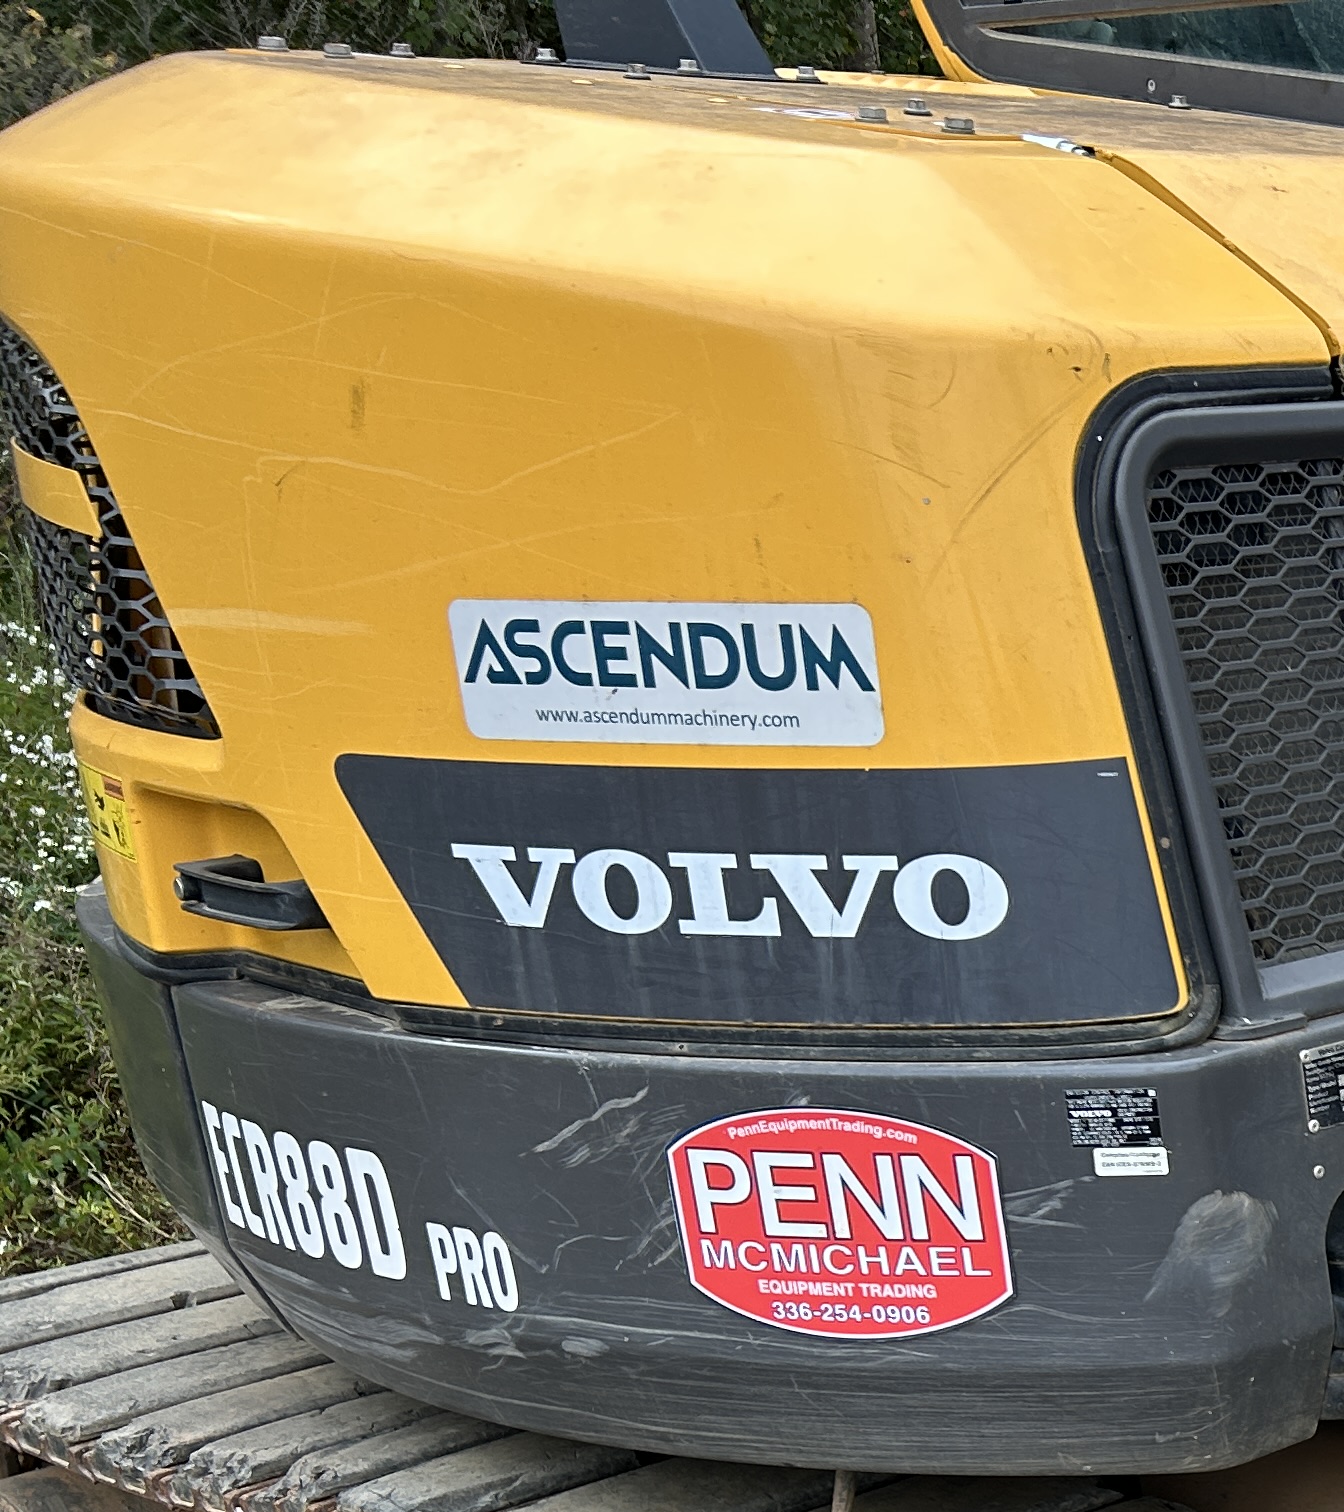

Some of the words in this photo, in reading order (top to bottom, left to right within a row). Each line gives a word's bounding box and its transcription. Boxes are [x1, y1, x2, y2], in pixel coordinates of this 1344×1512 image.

[463, 618, 876, 692] ASCENDUM
[535, 706, 800, 731] www.ascendummachinery.com
[450, 842, 1009, 941] VOLVO
[726, 1116, 918, 1145] PennEquipmentTrading.com
[1068, 1110, 1113, 1118] VOLVO
[202, 1100, 407, 1282] ECR88D
[425, 1221, 520, 1314] PRO
[685, 1147, 986, 1242] PENN
[700, 1238, 993, 1277] MCMICHAEL
[757, 1278, 855, 1298] EQUIPMENT
[857, 1281, 938, 1300] TRADING
[770, 1300, 931, 1325] 336-254-0906
